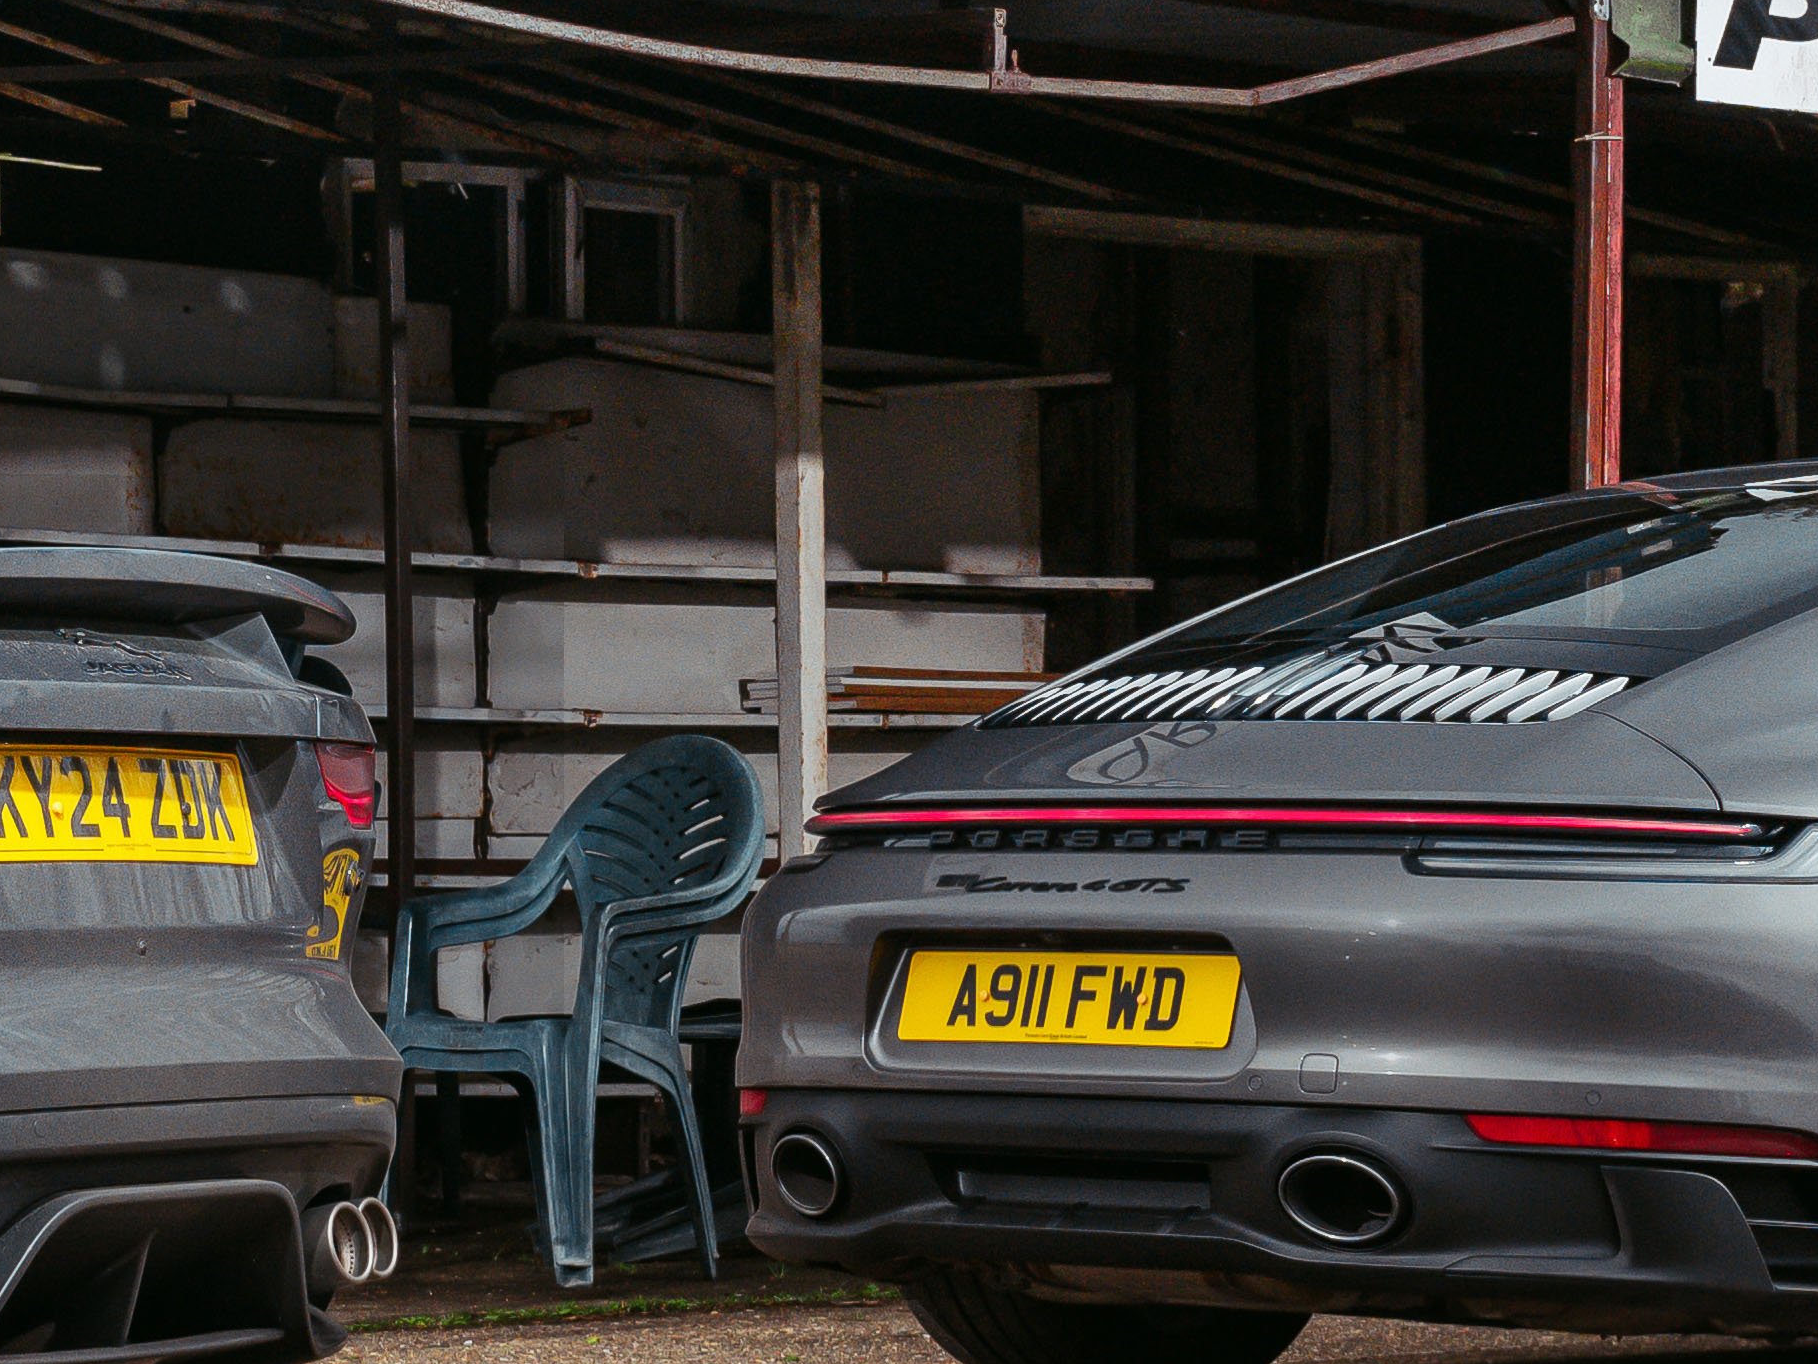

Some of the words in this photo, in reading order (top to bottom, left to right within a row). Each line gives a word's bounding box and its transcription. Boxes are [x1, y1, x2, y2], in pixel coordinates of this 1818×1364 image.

[137, 756, 236, 842] ZDK
[928, 828, 1272, 851] PORSCHE
[945, 962, 1060, 1030] A911
[1064, 965, 1186, 1033] FWD
